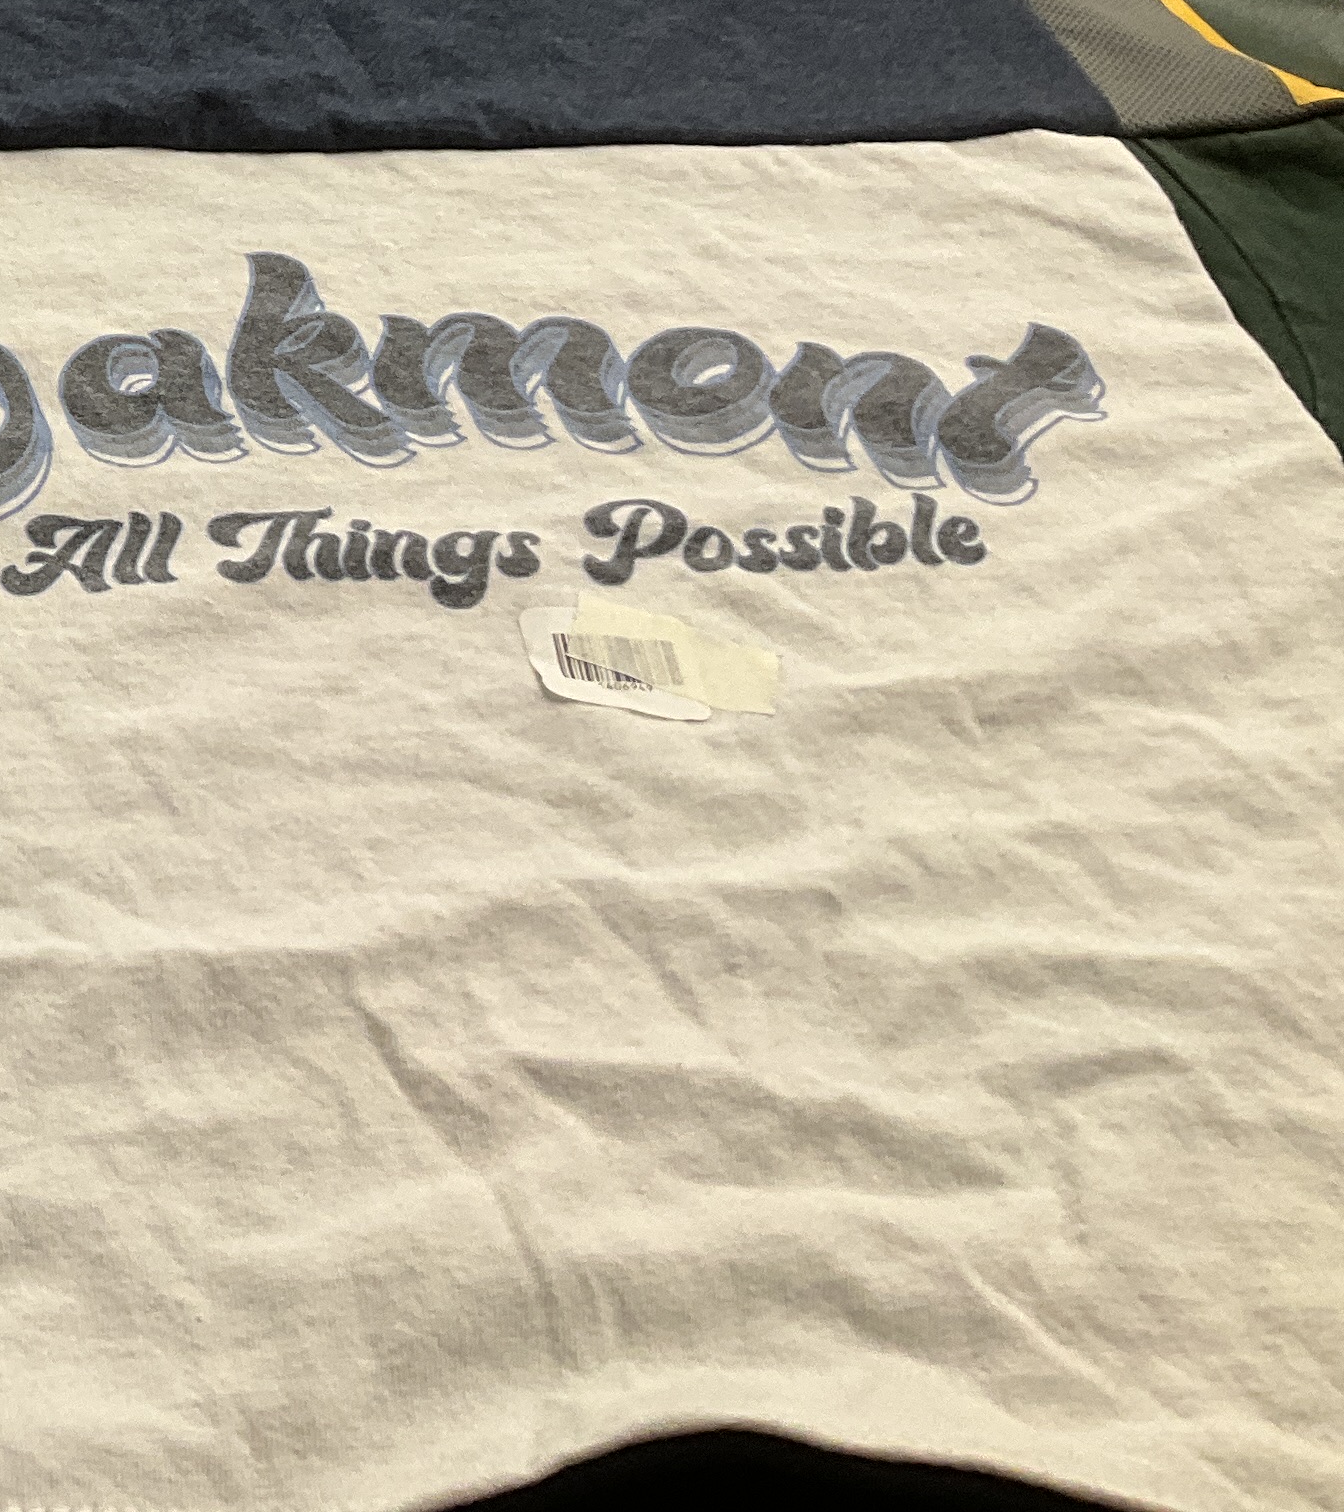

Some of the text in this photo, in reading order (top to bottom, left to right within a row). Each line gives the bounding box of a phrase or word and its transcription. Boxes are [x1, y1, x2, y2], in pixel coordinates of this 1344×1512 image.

[0, 494, 988, 608] All Things Possible
